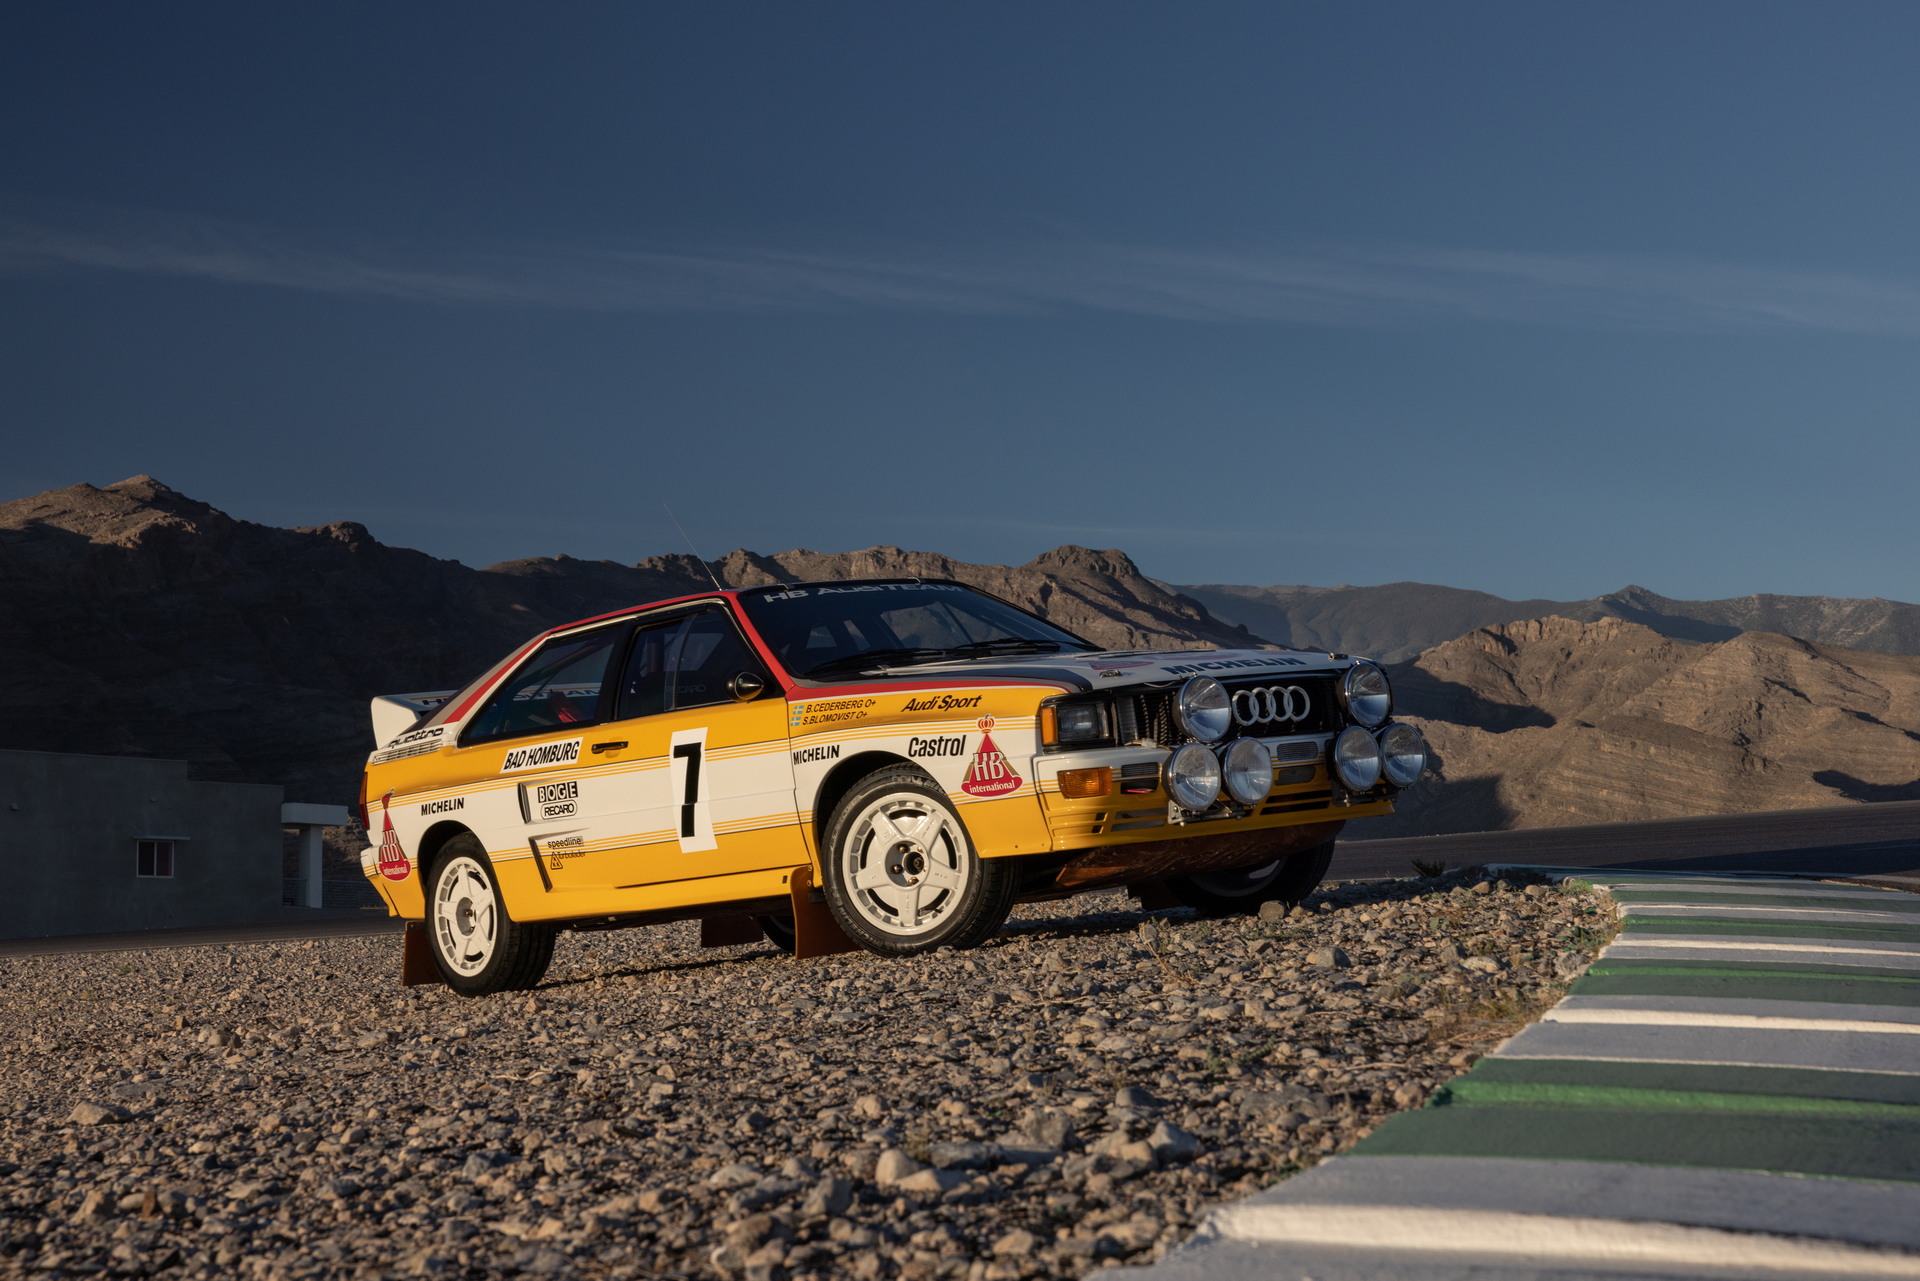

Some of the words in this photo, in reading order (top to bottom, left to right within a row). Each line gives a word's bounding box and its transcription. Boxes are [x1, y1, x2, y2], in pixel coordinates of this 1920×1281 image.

[763, 589, 809, 603] HB
[880, 583, 963, 592] TEAM
[1161, 657, 1307, 674] MICHELIN
[901, 696, 938, 712] Audi
[938, 694, 983, 711] Sport
[388, 728, 444, 749] quattro
[908, 735, 967, 757] Castrol
[504, 750, 527, 770] BAD
[526, 741, 580, 766] HOMBURG
[793, 745, 840, 765] MICHELIN
[972, 751, 1006, 782] HB
[538, 781, 578, 803] BOGE
[673, 742, 702, 838] 7
[969, 779, 1015, 794] international
[421, 797, 465, 816] MICHELIN
[544, 803, 575, 816] RECARO
[547, 837, 582, 850] speedline
